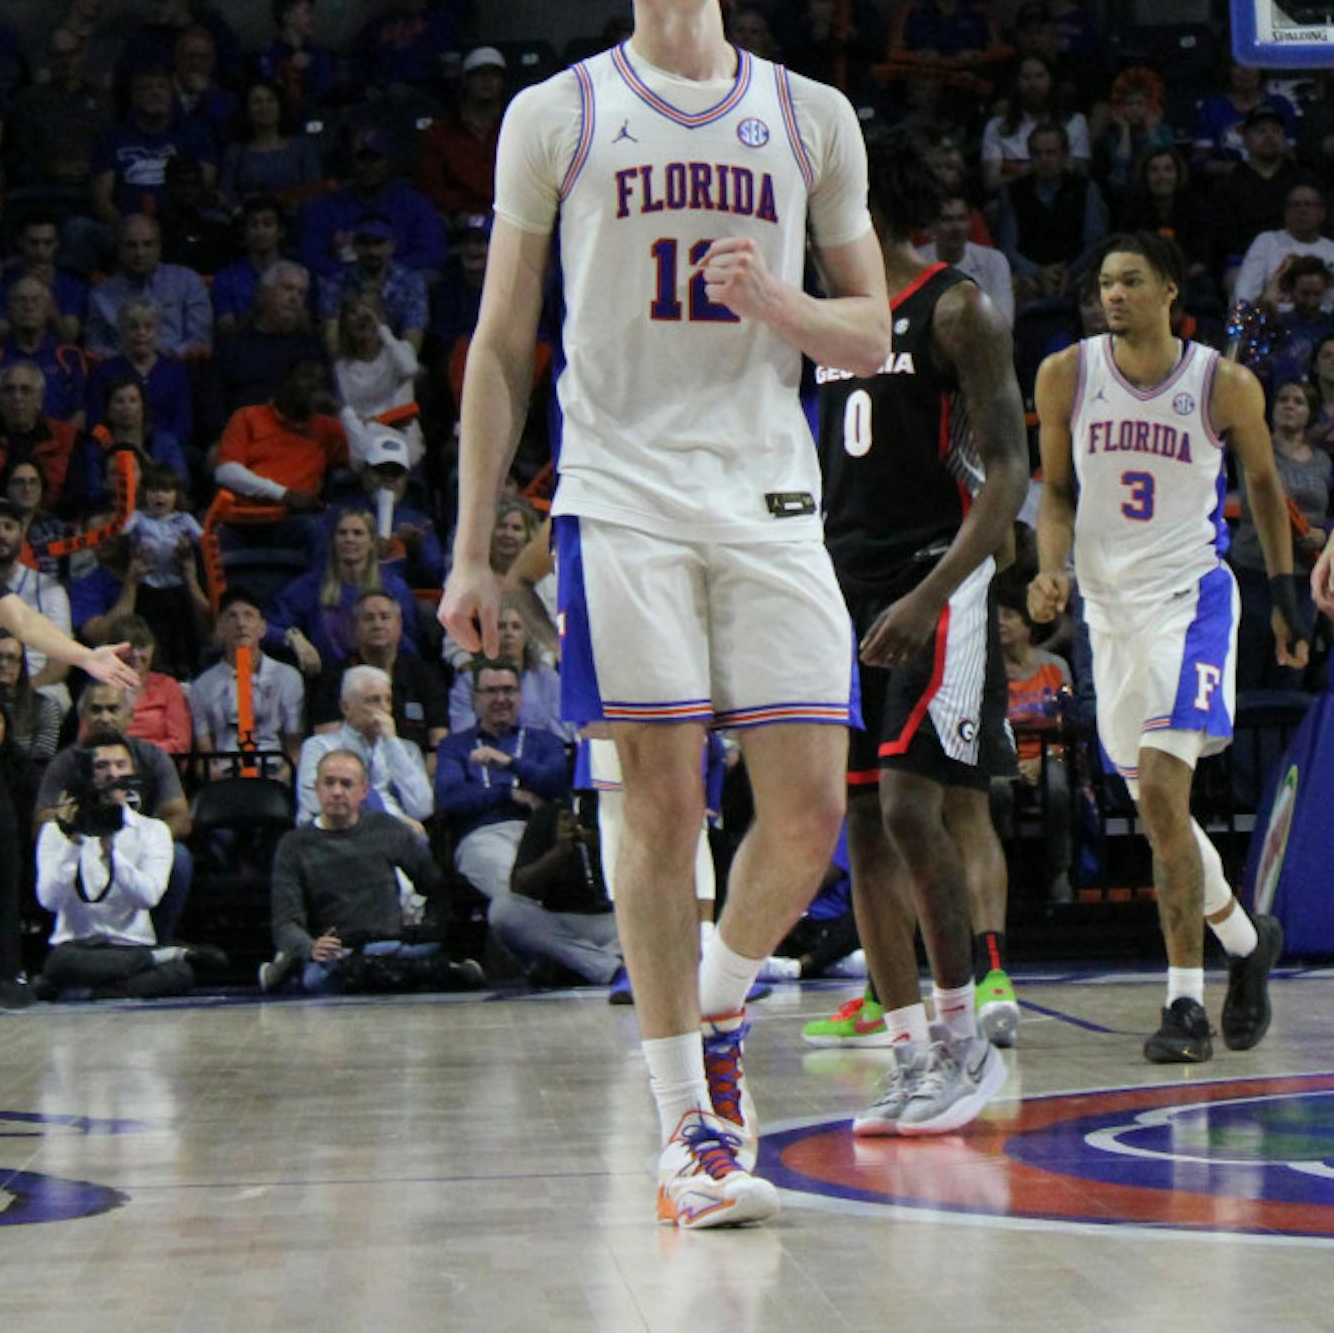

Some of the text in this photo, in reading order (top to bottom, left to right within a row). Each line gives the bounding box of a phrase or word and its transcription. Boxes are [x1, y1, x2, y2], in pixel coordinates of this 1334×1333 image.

[615, 161, 778, 225] FLORIDA
[843, 388, 873, 458] 0
[1088, 420, 1193, 464] FLORIDA
[1120, 470, 1155, 522] 3
[1194, 662, 1221, 711] F
